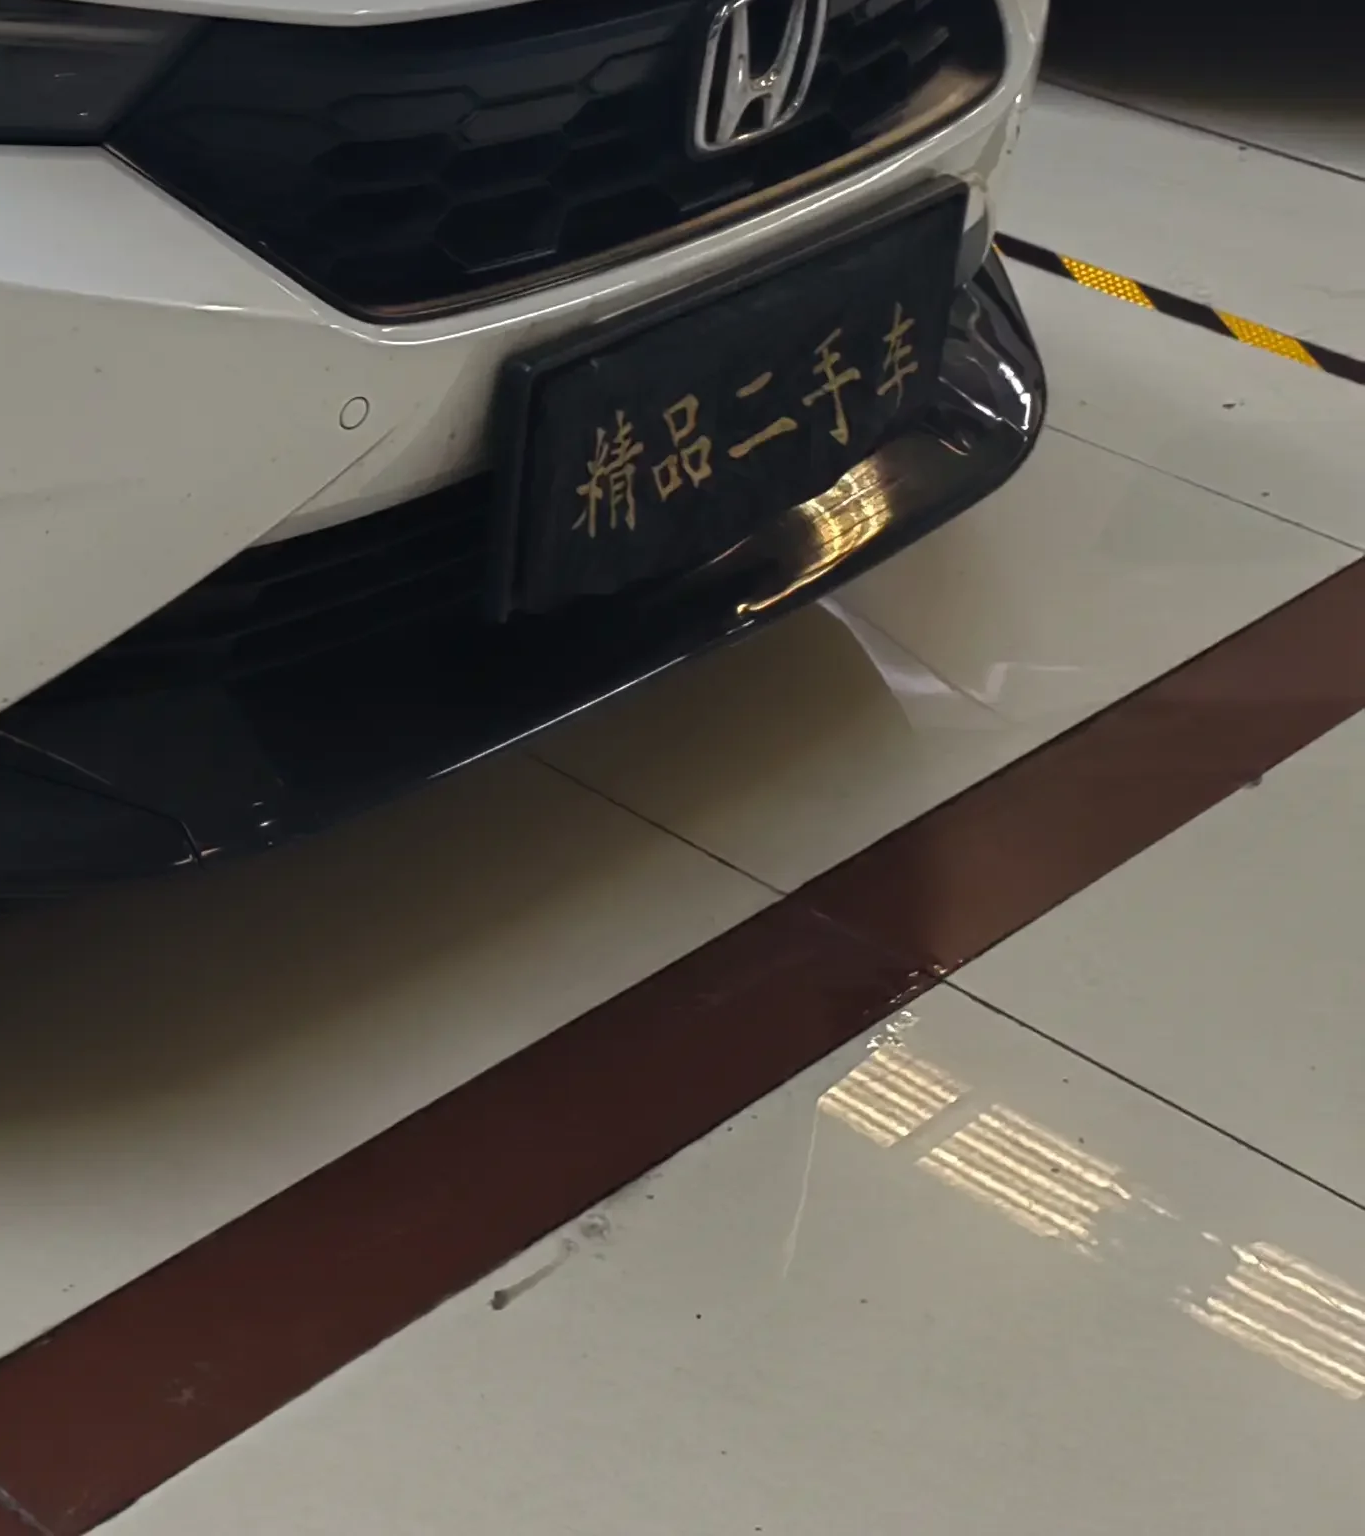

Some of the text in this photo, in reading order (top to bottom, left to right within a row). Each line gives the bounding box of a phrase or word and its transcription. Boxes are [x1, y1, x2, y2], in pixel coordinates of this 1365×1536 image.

[571, 301, 921, 539] 精品二手车
